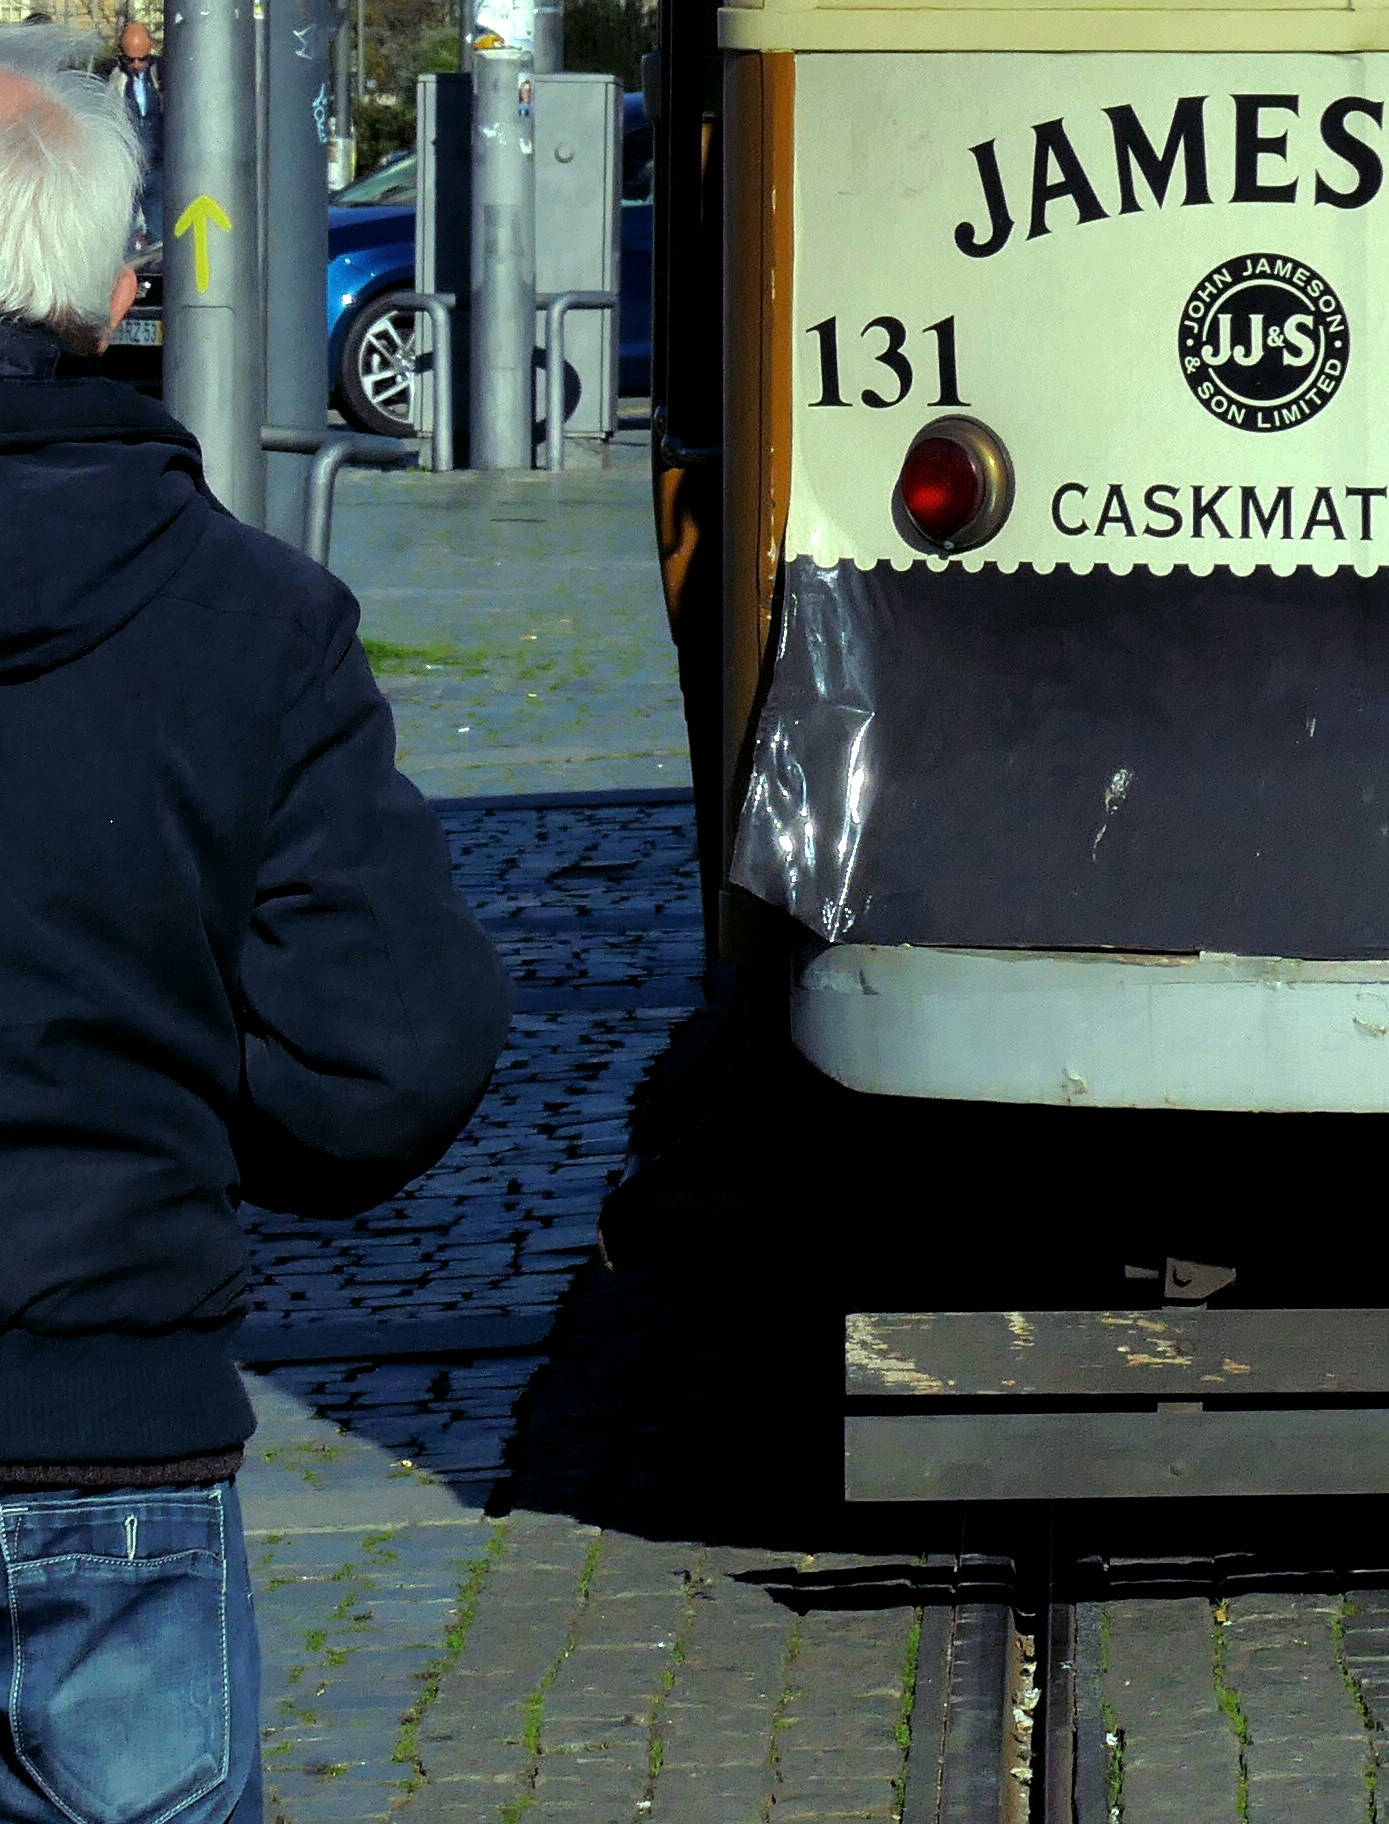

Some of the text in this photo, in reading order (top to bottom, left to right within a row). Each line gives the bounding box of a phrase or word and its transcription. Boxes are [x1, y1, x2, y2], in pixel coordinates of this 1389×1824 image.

[1184, 258, 1345, 334] JOHN JAMESON
[805, 315, 972, 409] 131
[1201, 313, 1316, 367] JJ&S
[1184, 356, 1342, 428] & SON LIMITED
